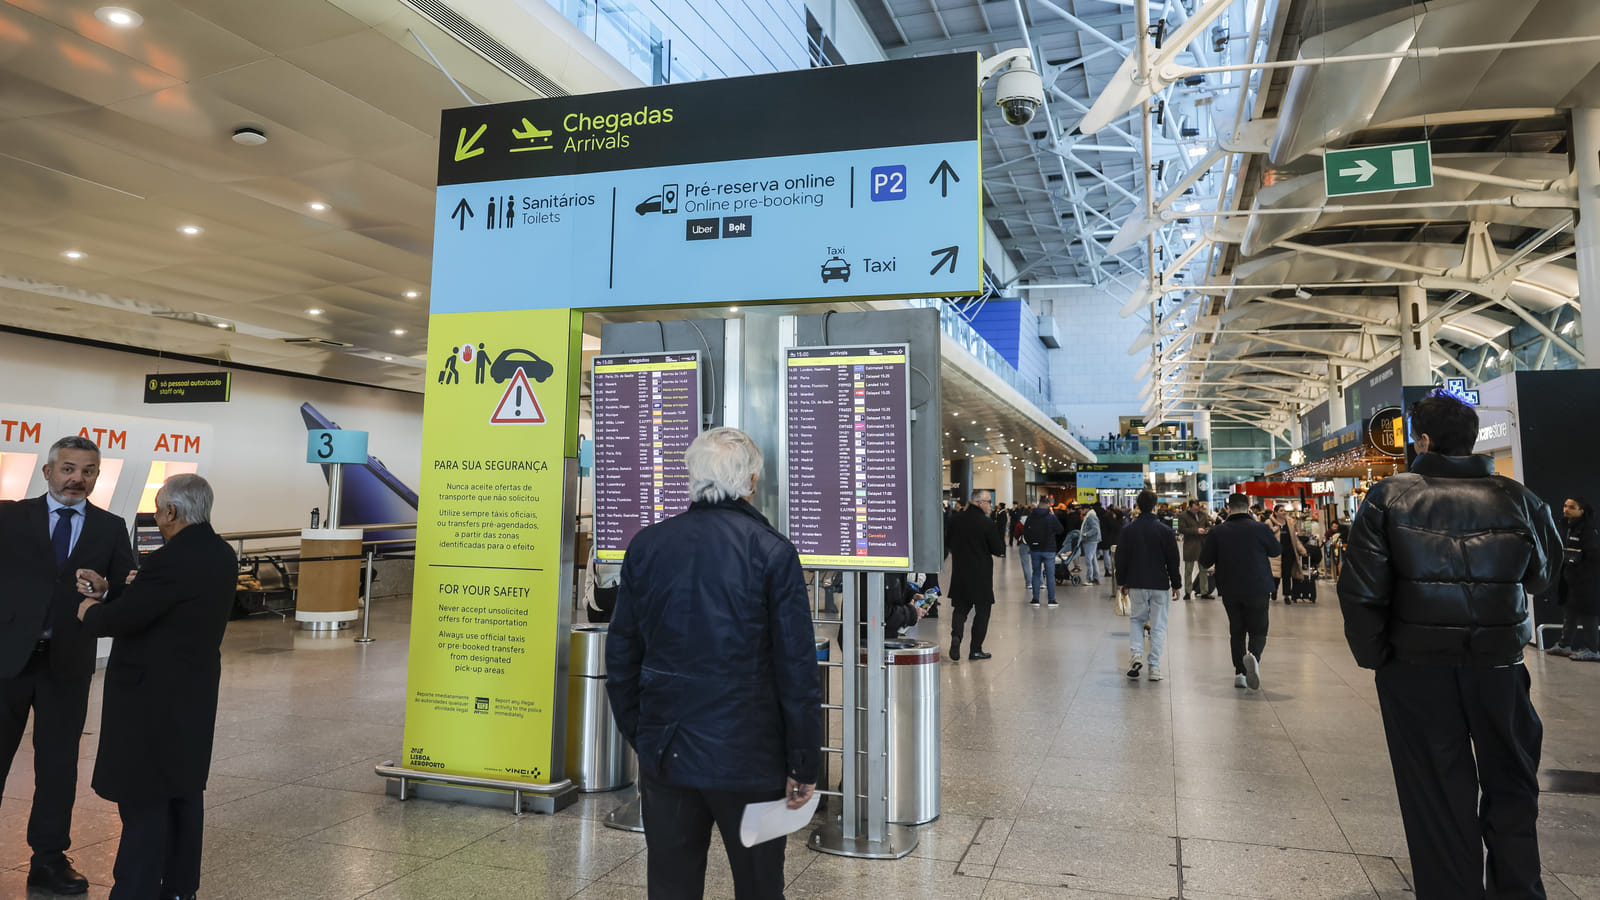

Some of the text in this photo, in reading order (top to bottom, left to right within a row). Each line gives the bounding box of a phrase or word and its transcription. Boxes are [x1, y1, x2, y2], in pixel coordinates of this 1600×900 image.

[563, 107, 674, 133] Chegadas
[564, 132, 630, 153] Arrivals
[686, 173, 835, 197] Pré-reserva online
[874, 173, 904, 194] P2
[522, 193, 595, 210] Sanitários
[685, 192, 823, 213] Online pre-booking
[522, 211, 560, 225] Toilets
[692, 225, 713, 234] Uber
[728, 222, 746, 233] Bolt
[864, 257, 896, 273] Taxi
[0, 420, 41, 443] TM
[78, 427, 127, 450] ATM
[154, 433, 200, 454] ATM
[317, 433, 334, 458] 3
[434, 460, 548, 473] PARA SUA SEGURANÇA
[439, 494, 476, 502] transporte
[482, 521, 539, 530] pré-agendados,
[440, 584, 530, 598] FOR YOUR SAFETY
[461, 606, 486, 614] accept
[488, 607, 528, 616] unsolicited
[474, 618, 527, 627] transportation
[439, 630, 463, 640] Always
[480, 632, 506, 641] official
[448, 643, 489, 652] pre-booked
[492, 645, 525, 654] transfers
[470, 655, 511, 664] designated
[455, 664, 482, 673] pick-up
[410, 760, 445, 768] AEROPORTO
